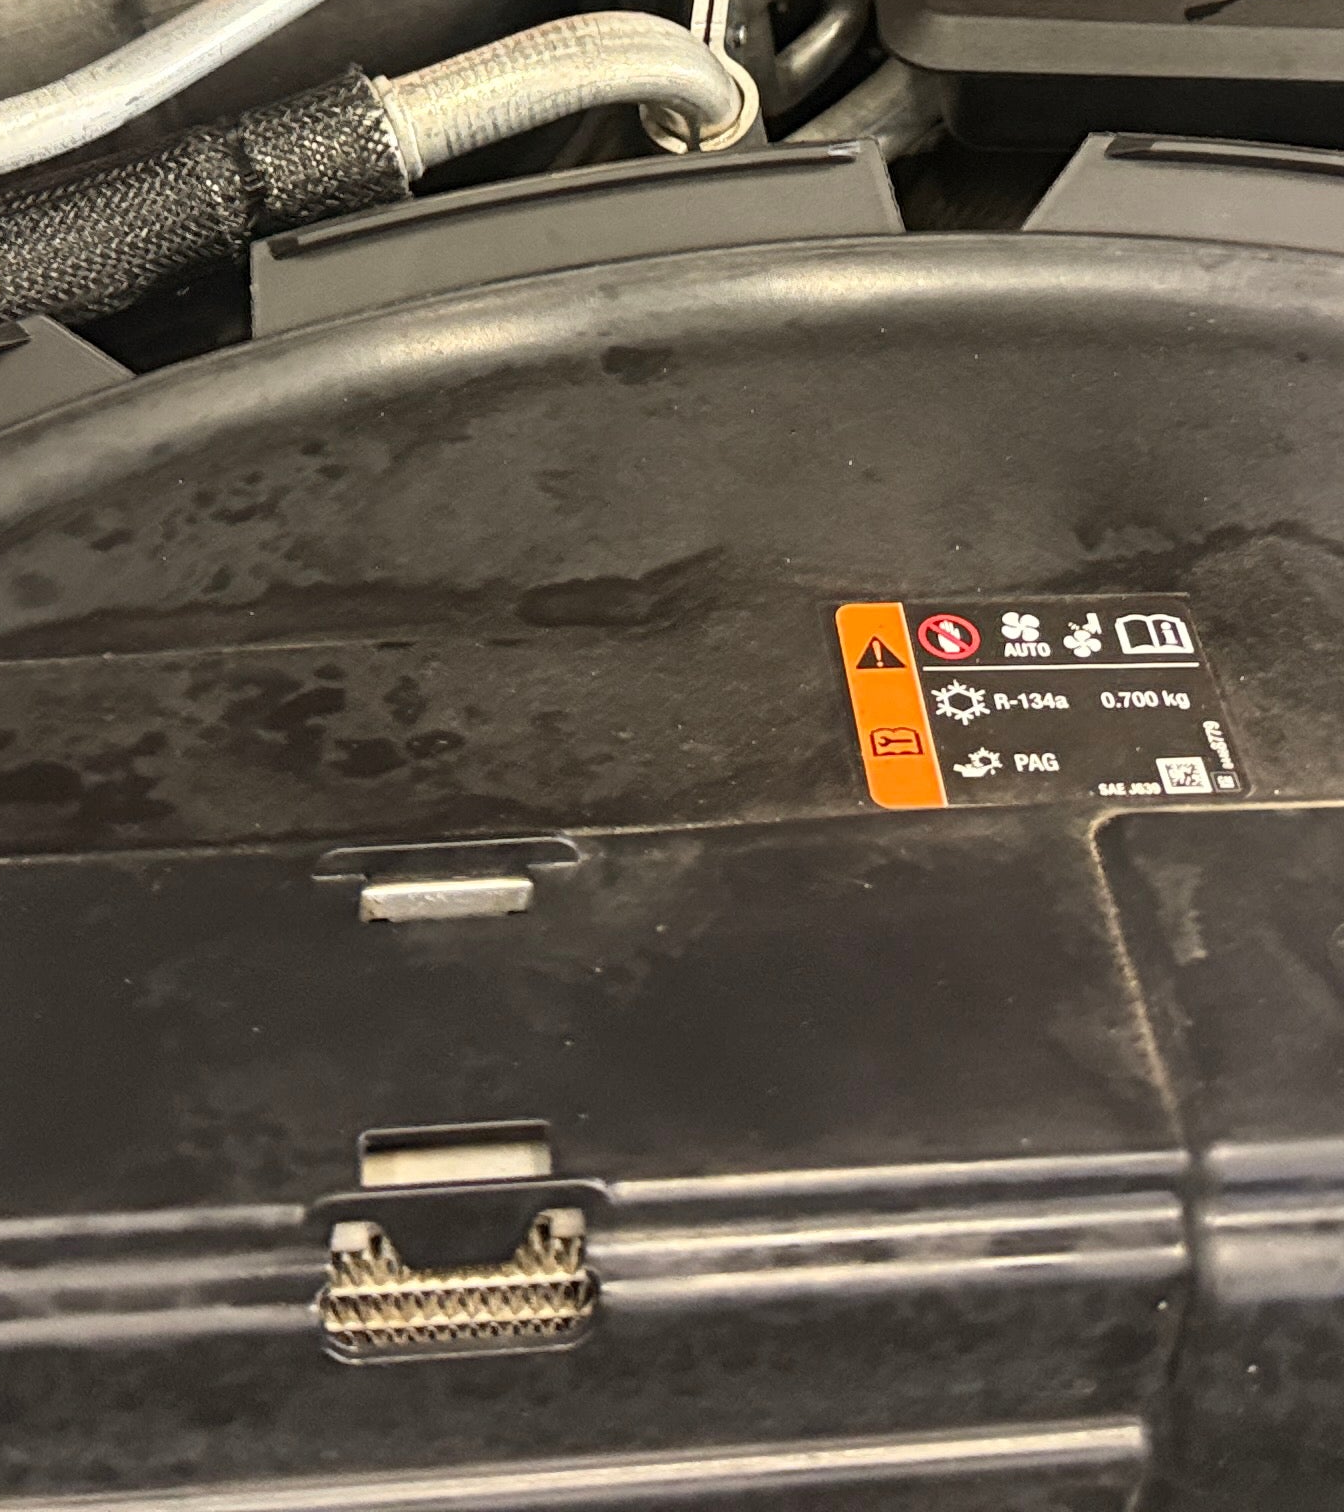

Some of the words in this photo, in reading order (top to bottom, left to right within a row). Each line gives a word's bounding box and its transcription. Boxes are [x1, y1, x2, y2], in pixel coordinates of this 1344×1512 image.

[1004, 641, 1052, 658] AUTO
[993, 692, 1070, 711] R-134a
[1100, 690, 1159, 709] 0.700
[1161, 689, 1191, 710] kg
[1013, 752, 1060, 772] PAG
[1098, 782, 1127, 796] SAE
